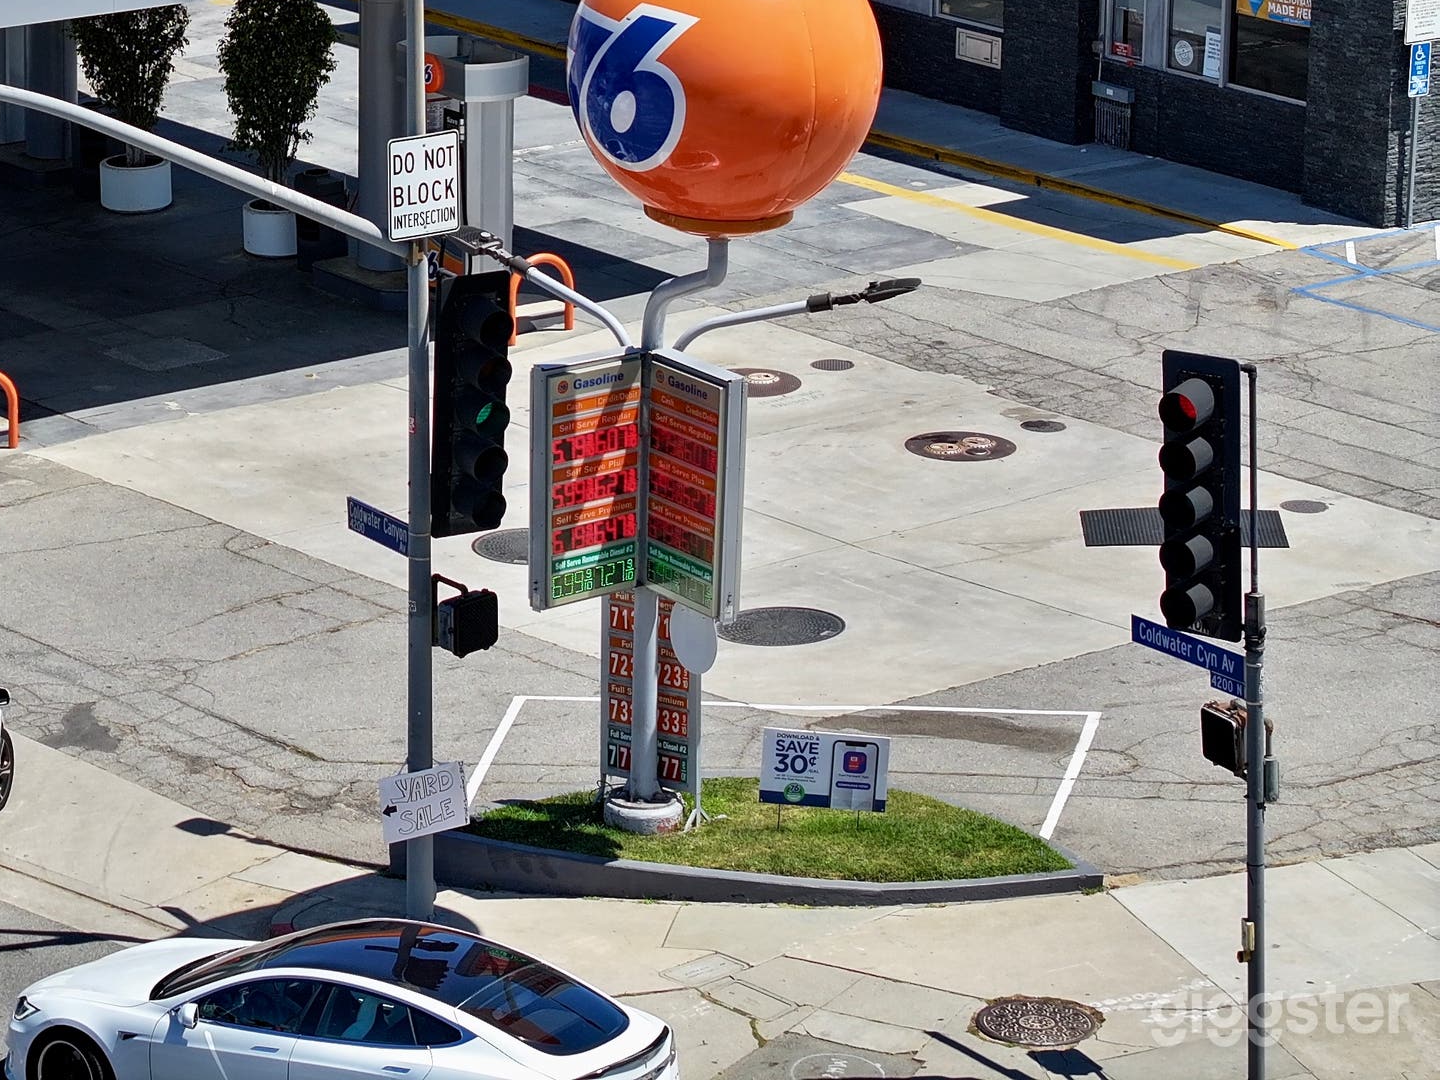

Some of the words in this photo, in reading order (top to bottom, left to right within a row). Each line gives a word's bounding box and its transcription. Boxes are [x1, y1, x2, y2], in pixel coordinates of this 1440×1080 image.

[1268, 1, 1295, 17] MADE
[393, 152, 415, 175] DO
[425, 145, 454, 171] NOT
[393, 177, 455, 208] BLOCK
[394, 206, 456, 230] INTERSECTION
[573, 372, 624, 390] Gasoline
[667, 375, 708, 400] Gasoline
[566, 403, 583, 411] Cash
[560, 422, 574, 432] Self
[576, 418, 598, 429] Serve
[602, 412, 631, 424] Regular
[655, 412, 668, 423] Self
[669, 417, 687, 431] Serve
[688, 426, 712, 441] Regular
[566, 467, 581, 477] Self
[584, 463, 606, 473] Serve
[672, 465, 690, 478] Serve
[556, 515, 571, 525] Self
[574, 510, 596, 520] Serve
[598, 502, 633, 515] Premium
[683, 516, 711, 533] Premium
[610, 547, 625, 557] Diesel
[626, 544, 633, 553] #2
[616, 591, 629, 600] Full
[661, 648, 676, 658] Plu
[1139, 622, 1192, 657] Coldwater
[1196, 644, 1218, 669] Cyn
[1222, 654, 1235, 674] Av
[658, 662, 681, 687] 23
[611, 684, 625, 694] Full
[1212, 675, 1233, 692] 4200
[1236, 686, 1243, 697] N
[610, 699, 633, 722] 73
[657, 709, 680, 733] 33
[610, 729, 620, 739] Full
[620, 731, 632, 741] Serv
[776, 732, 814, 741] DOWNLOAD
[609, 744, 632, 768] 77
[663, 741, 679, 752] Diesel
[680, 745, 687, 754] #2
[776, 740, 820, 755] SAVE
[657, 755, 679, 779] 77
[774, 753, 817, 774] 30¢
[389, 770, 454, 804] YARD
[398, 797, 455, 835] SALE
